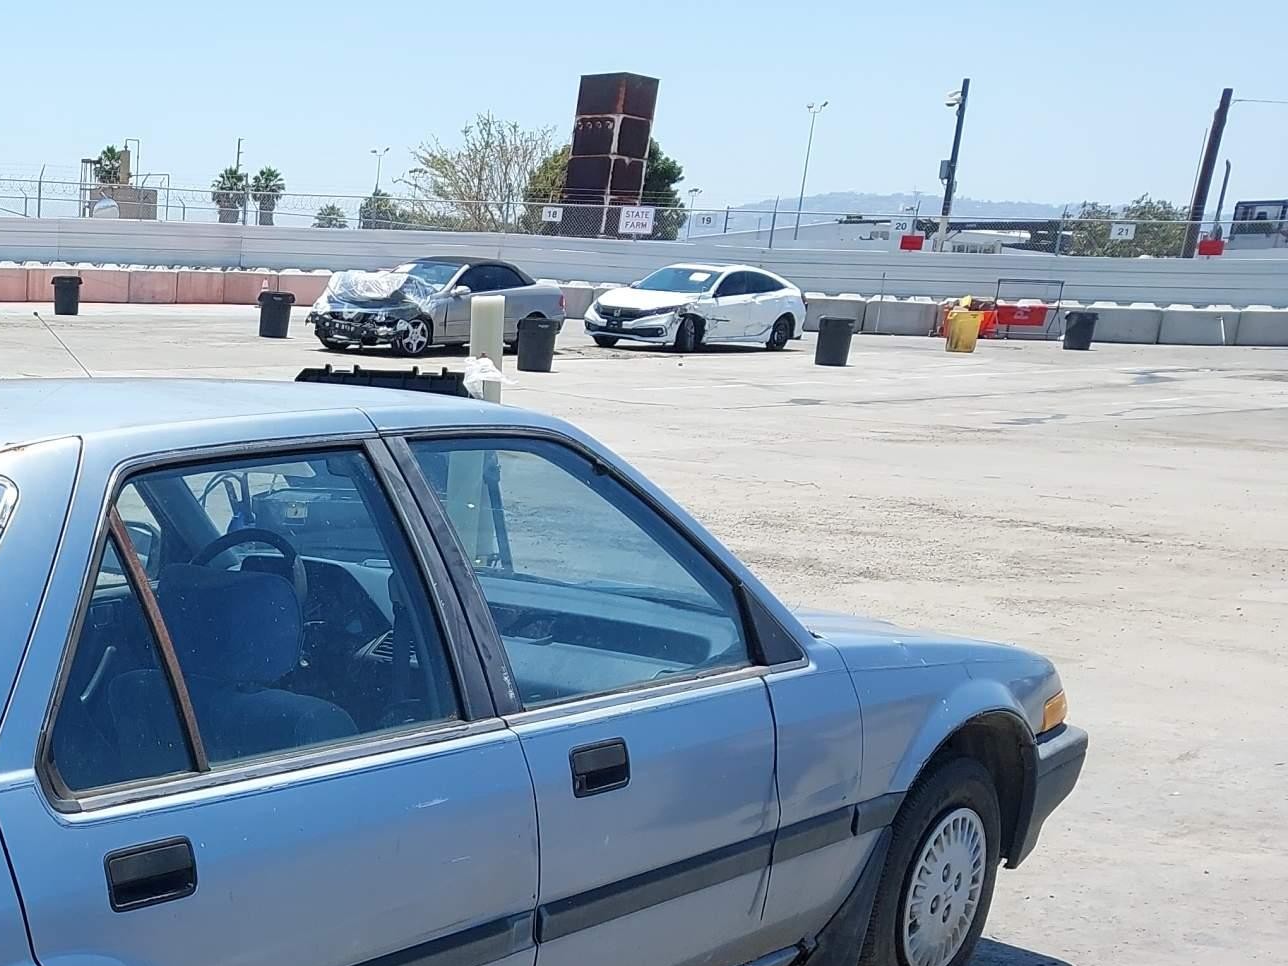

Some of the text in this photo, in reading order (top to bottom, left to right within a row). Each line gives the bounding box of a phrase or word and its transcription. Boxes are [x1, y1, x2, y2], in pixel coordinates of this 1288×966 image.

[547, 210, 558, 219] 18
[625, 210, 650, 219] STATE
[624, 221, 648, 229] FARM
[702, 216, 712, 225] 19
[895, 222, 907, 231] 20
[1117, 227, 1129, 236] 21
